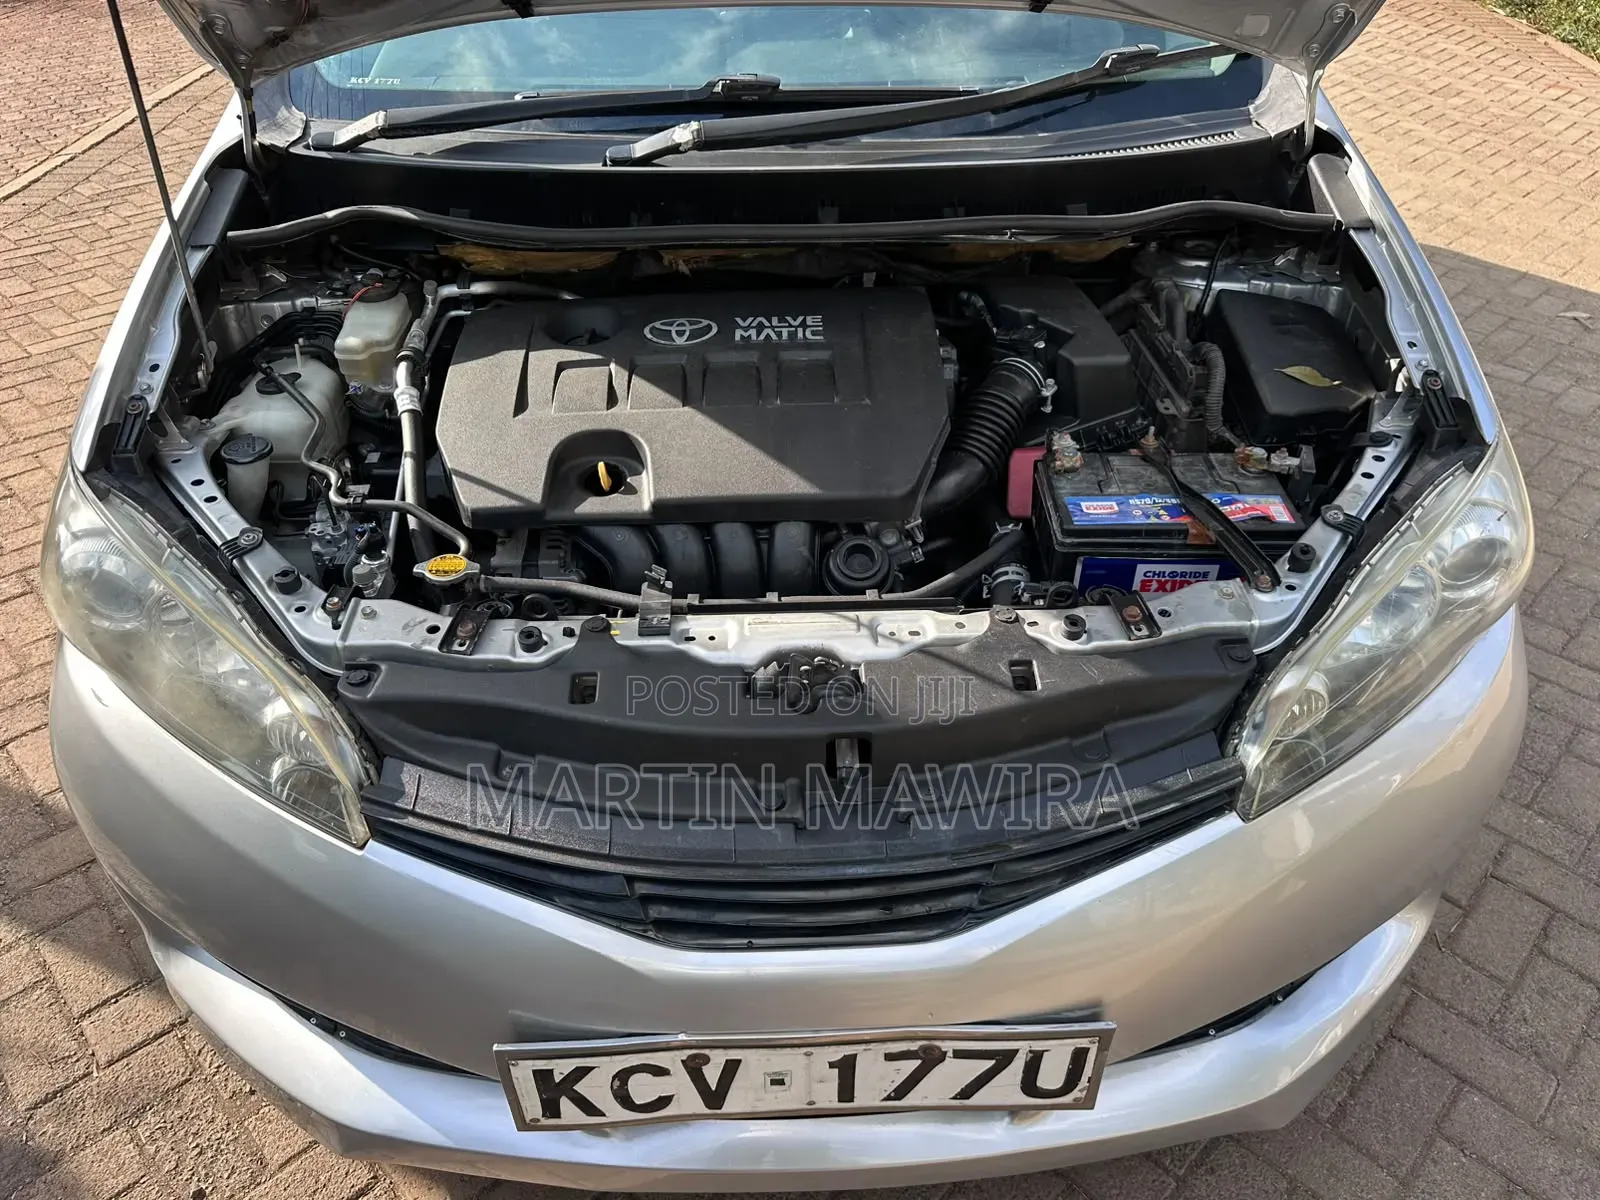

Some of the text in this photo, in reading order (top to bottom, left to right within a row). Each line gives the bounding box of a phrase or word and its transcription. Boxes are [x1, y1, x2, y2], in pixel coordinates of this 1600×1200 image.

[734, 315, 823, 327] VALVE
[734, 327, 825, 341] MATIC
[1142, 570, 1211, 579] CHLORIDE
[1138, 579, 1208, 593] EXID
[531, 1045, 1092, 1119] KCV 177U
